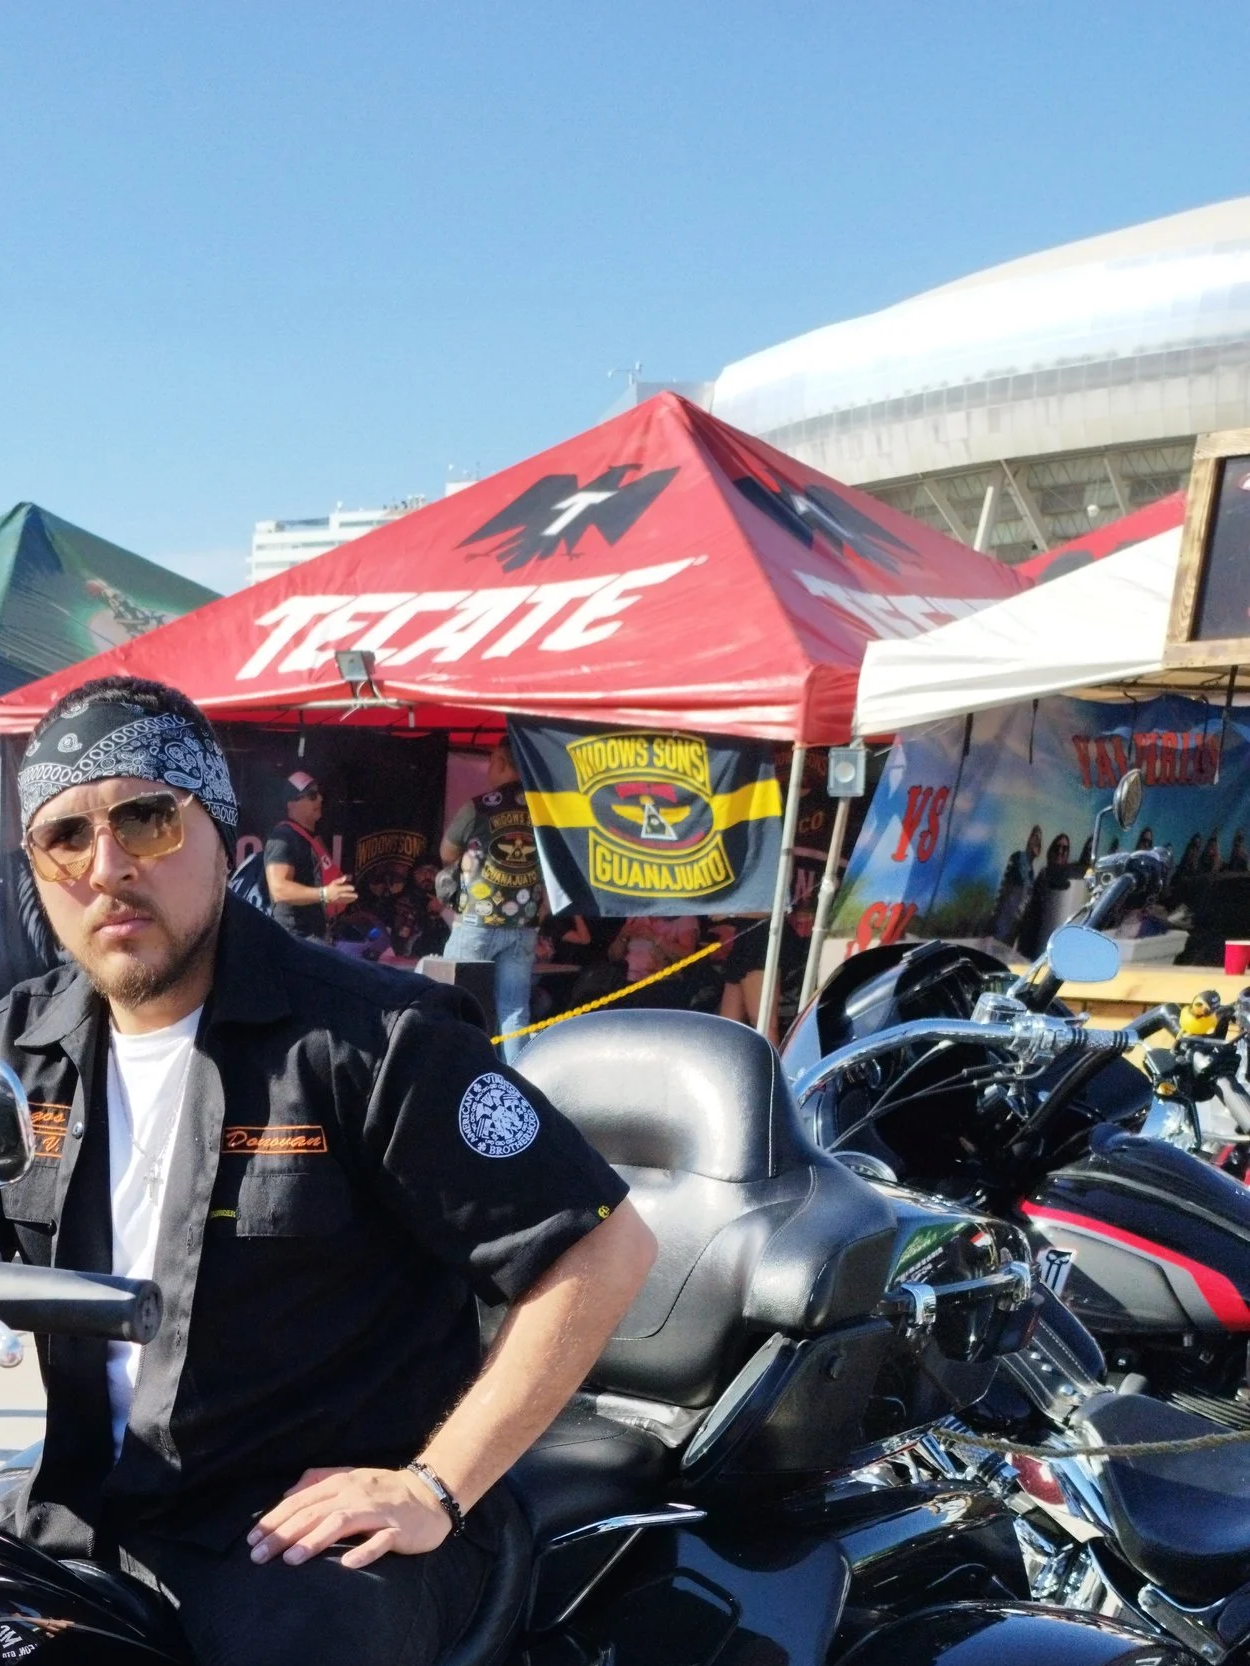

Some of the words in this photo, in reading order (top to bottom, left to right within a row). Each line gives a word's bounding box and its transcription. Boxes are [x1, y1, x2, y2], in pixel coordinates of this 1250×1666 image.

[236, 556, 696, 680] TECATE
[575, 737, 649, 783] WIDOWS
[653, 737, 706, 783] SONS
[595, 844, 727, 891] GUANAJUATO
[225, 1130, 322, 1148] Donovan
[462, 1093, 478, 1143] AMERICAN
